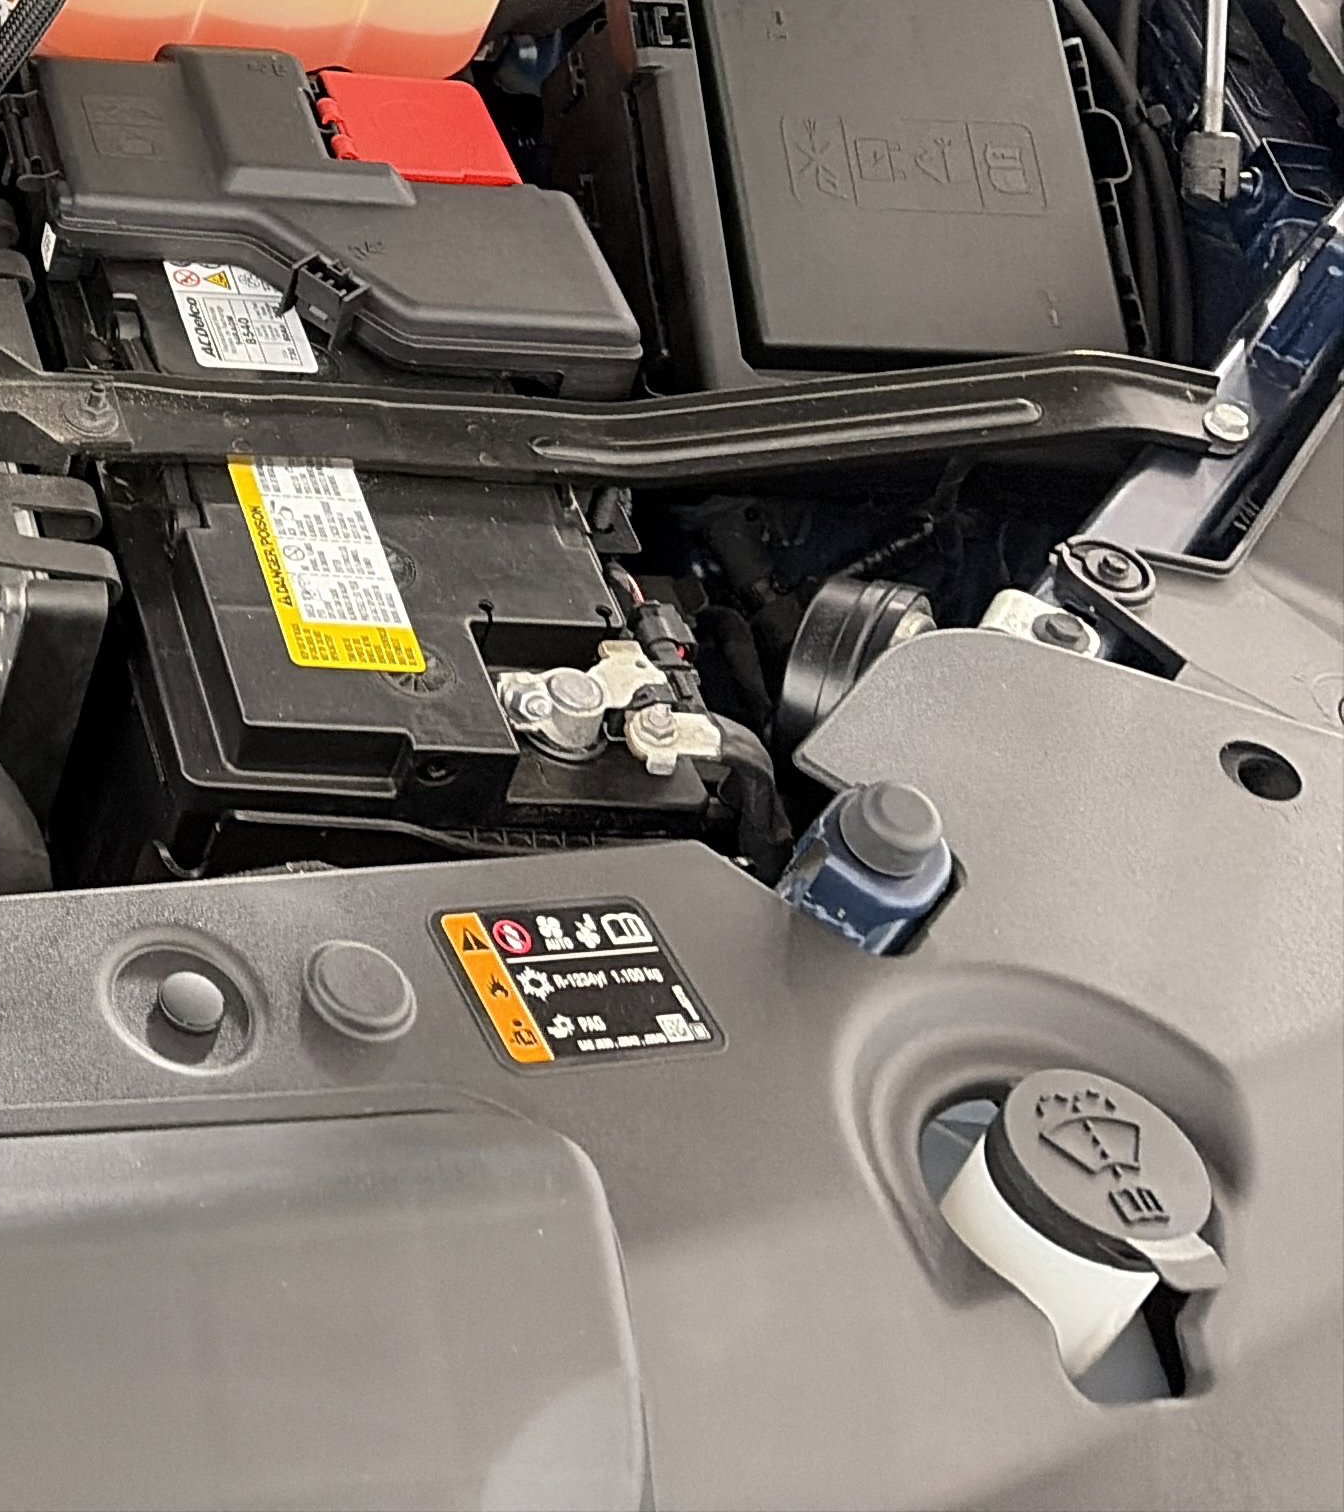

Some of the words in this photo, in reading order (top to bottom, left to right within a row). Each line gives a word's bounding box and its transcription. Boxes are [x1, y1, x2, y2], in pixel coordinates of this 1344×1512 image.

[186, 296, 216, 357] ACDelco
[248, 504, 273, 546] POISON
[266, 548, 288, 594] DANGER
[545, 936, 575, 951] AUTO
[611, 967, 642, 985] 1.100
[643, 965, 663, 984] kg
[576, 1014, 607, 1033] PAG
